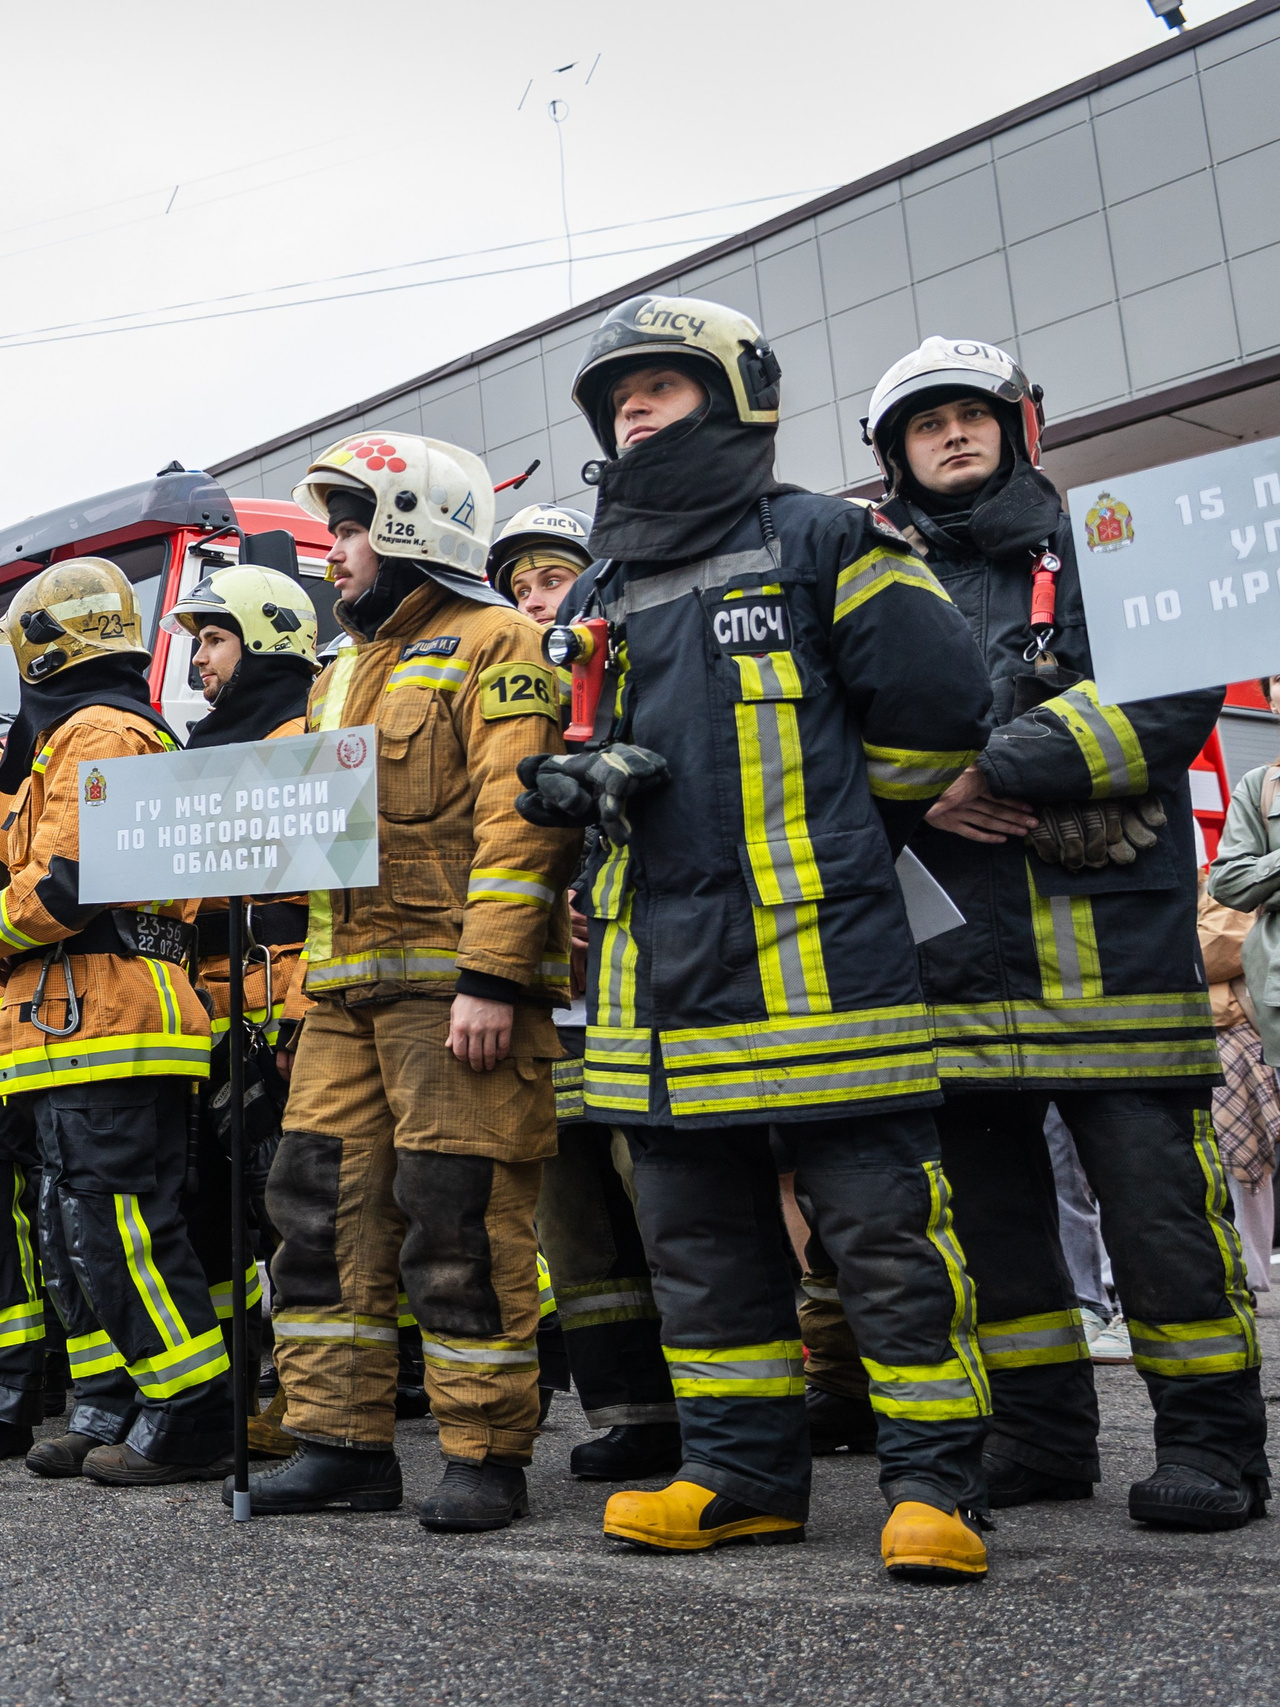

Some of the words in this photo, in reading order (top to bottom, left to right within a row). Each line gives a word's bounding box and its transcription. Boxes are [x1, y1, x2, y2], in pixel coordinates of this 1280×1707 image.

[635, 311, 706, 338] СПСЧ
[1174, 486, 1225, 526] 15
[385, 521, 416, 537] 126
[533, 517, 578, 533] СПСЧ
[1123, 589, 1182, 629] ПО
[1208, 568, 1280, 612] КР
[713, 606, 785, 645] СПСЧ
[489, 674, 550, 705] 126
[135, 799, 162, 822] ГУ
[175, 792, 222, 819] МЧС
[236, 780, 329, 813] РОССИИ
[117, 828, 145, 851] ПО
[158, 806, 347, 848] НОВГОРОДСКОЙ
[173, 844, 278, 875] ОБЛАСТИ
[136, 913, 182, 942] 23-56
